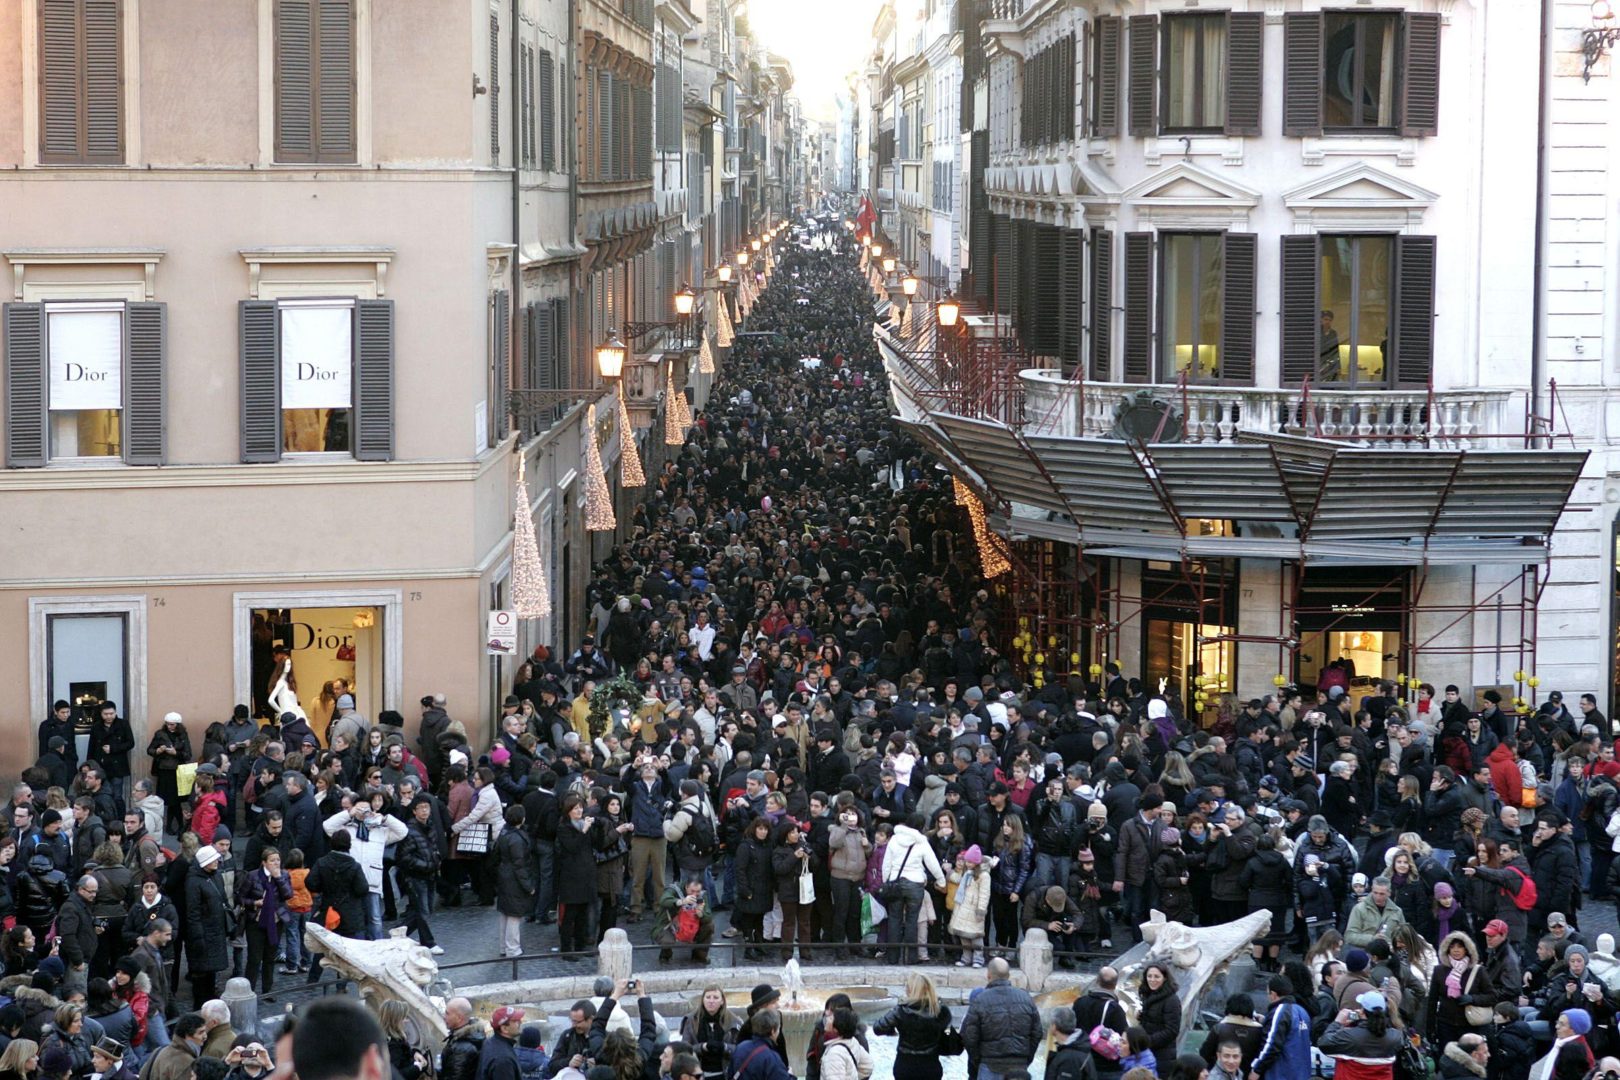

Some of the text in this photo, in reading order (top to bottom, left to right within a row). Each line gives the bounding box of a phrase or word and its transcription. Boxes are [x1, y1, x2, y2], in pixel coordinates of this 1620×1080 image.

[64, 362, 108, 381] Dior
[296, 362, 339, 380] Dior
[153, 597, 166, 607] 74
[410, 591, 422, 601] 75
[289, 622, 353, 650] Dior
